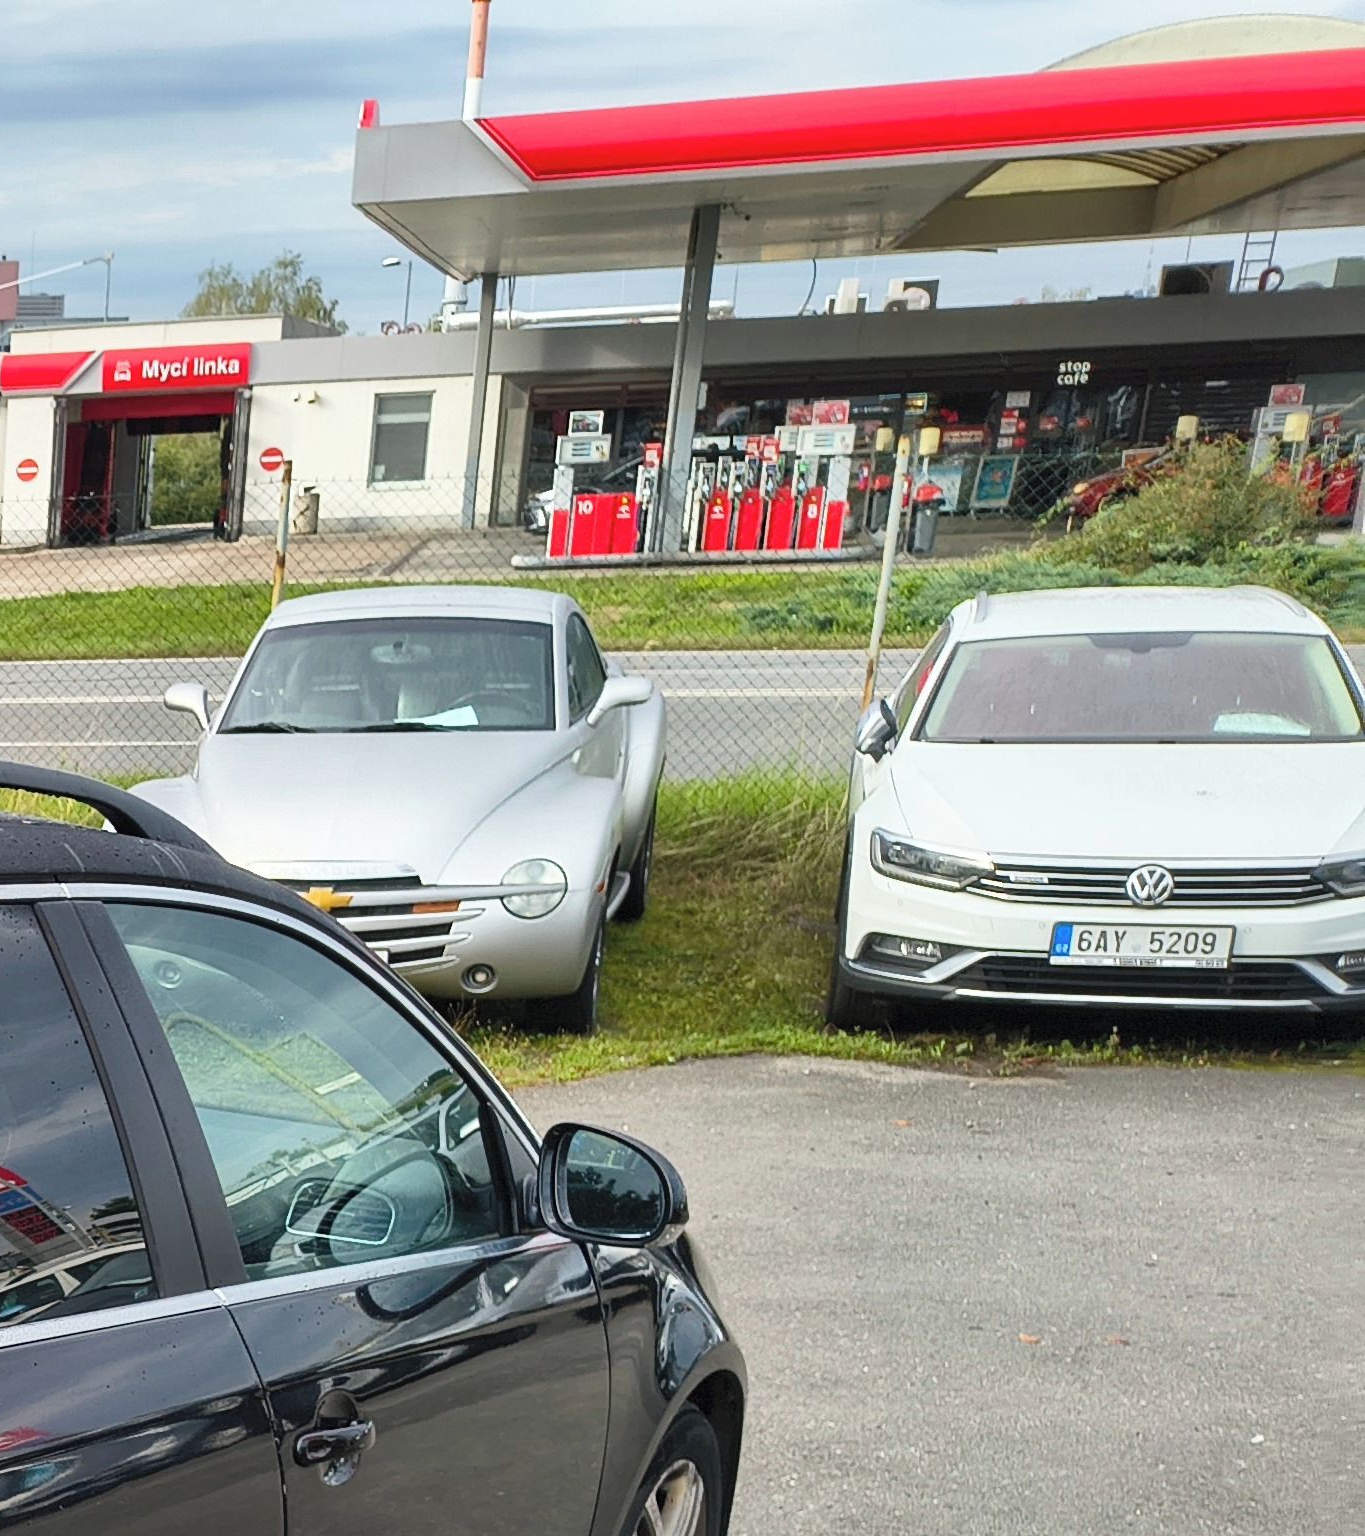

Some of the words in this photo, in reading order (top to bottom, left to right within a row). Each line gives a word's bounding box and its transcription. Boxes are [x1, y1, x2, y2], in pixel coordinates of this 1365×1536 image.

[142, 356, 190, 382] Mycí
[193, 356, 240, 376] linka
[1058, 360, 1091, 374] stop
[577, 499, 594, 515] 10
[1077, 930, 1127, 953] 6AY
[1148, 931, 1217, 955] 5209
